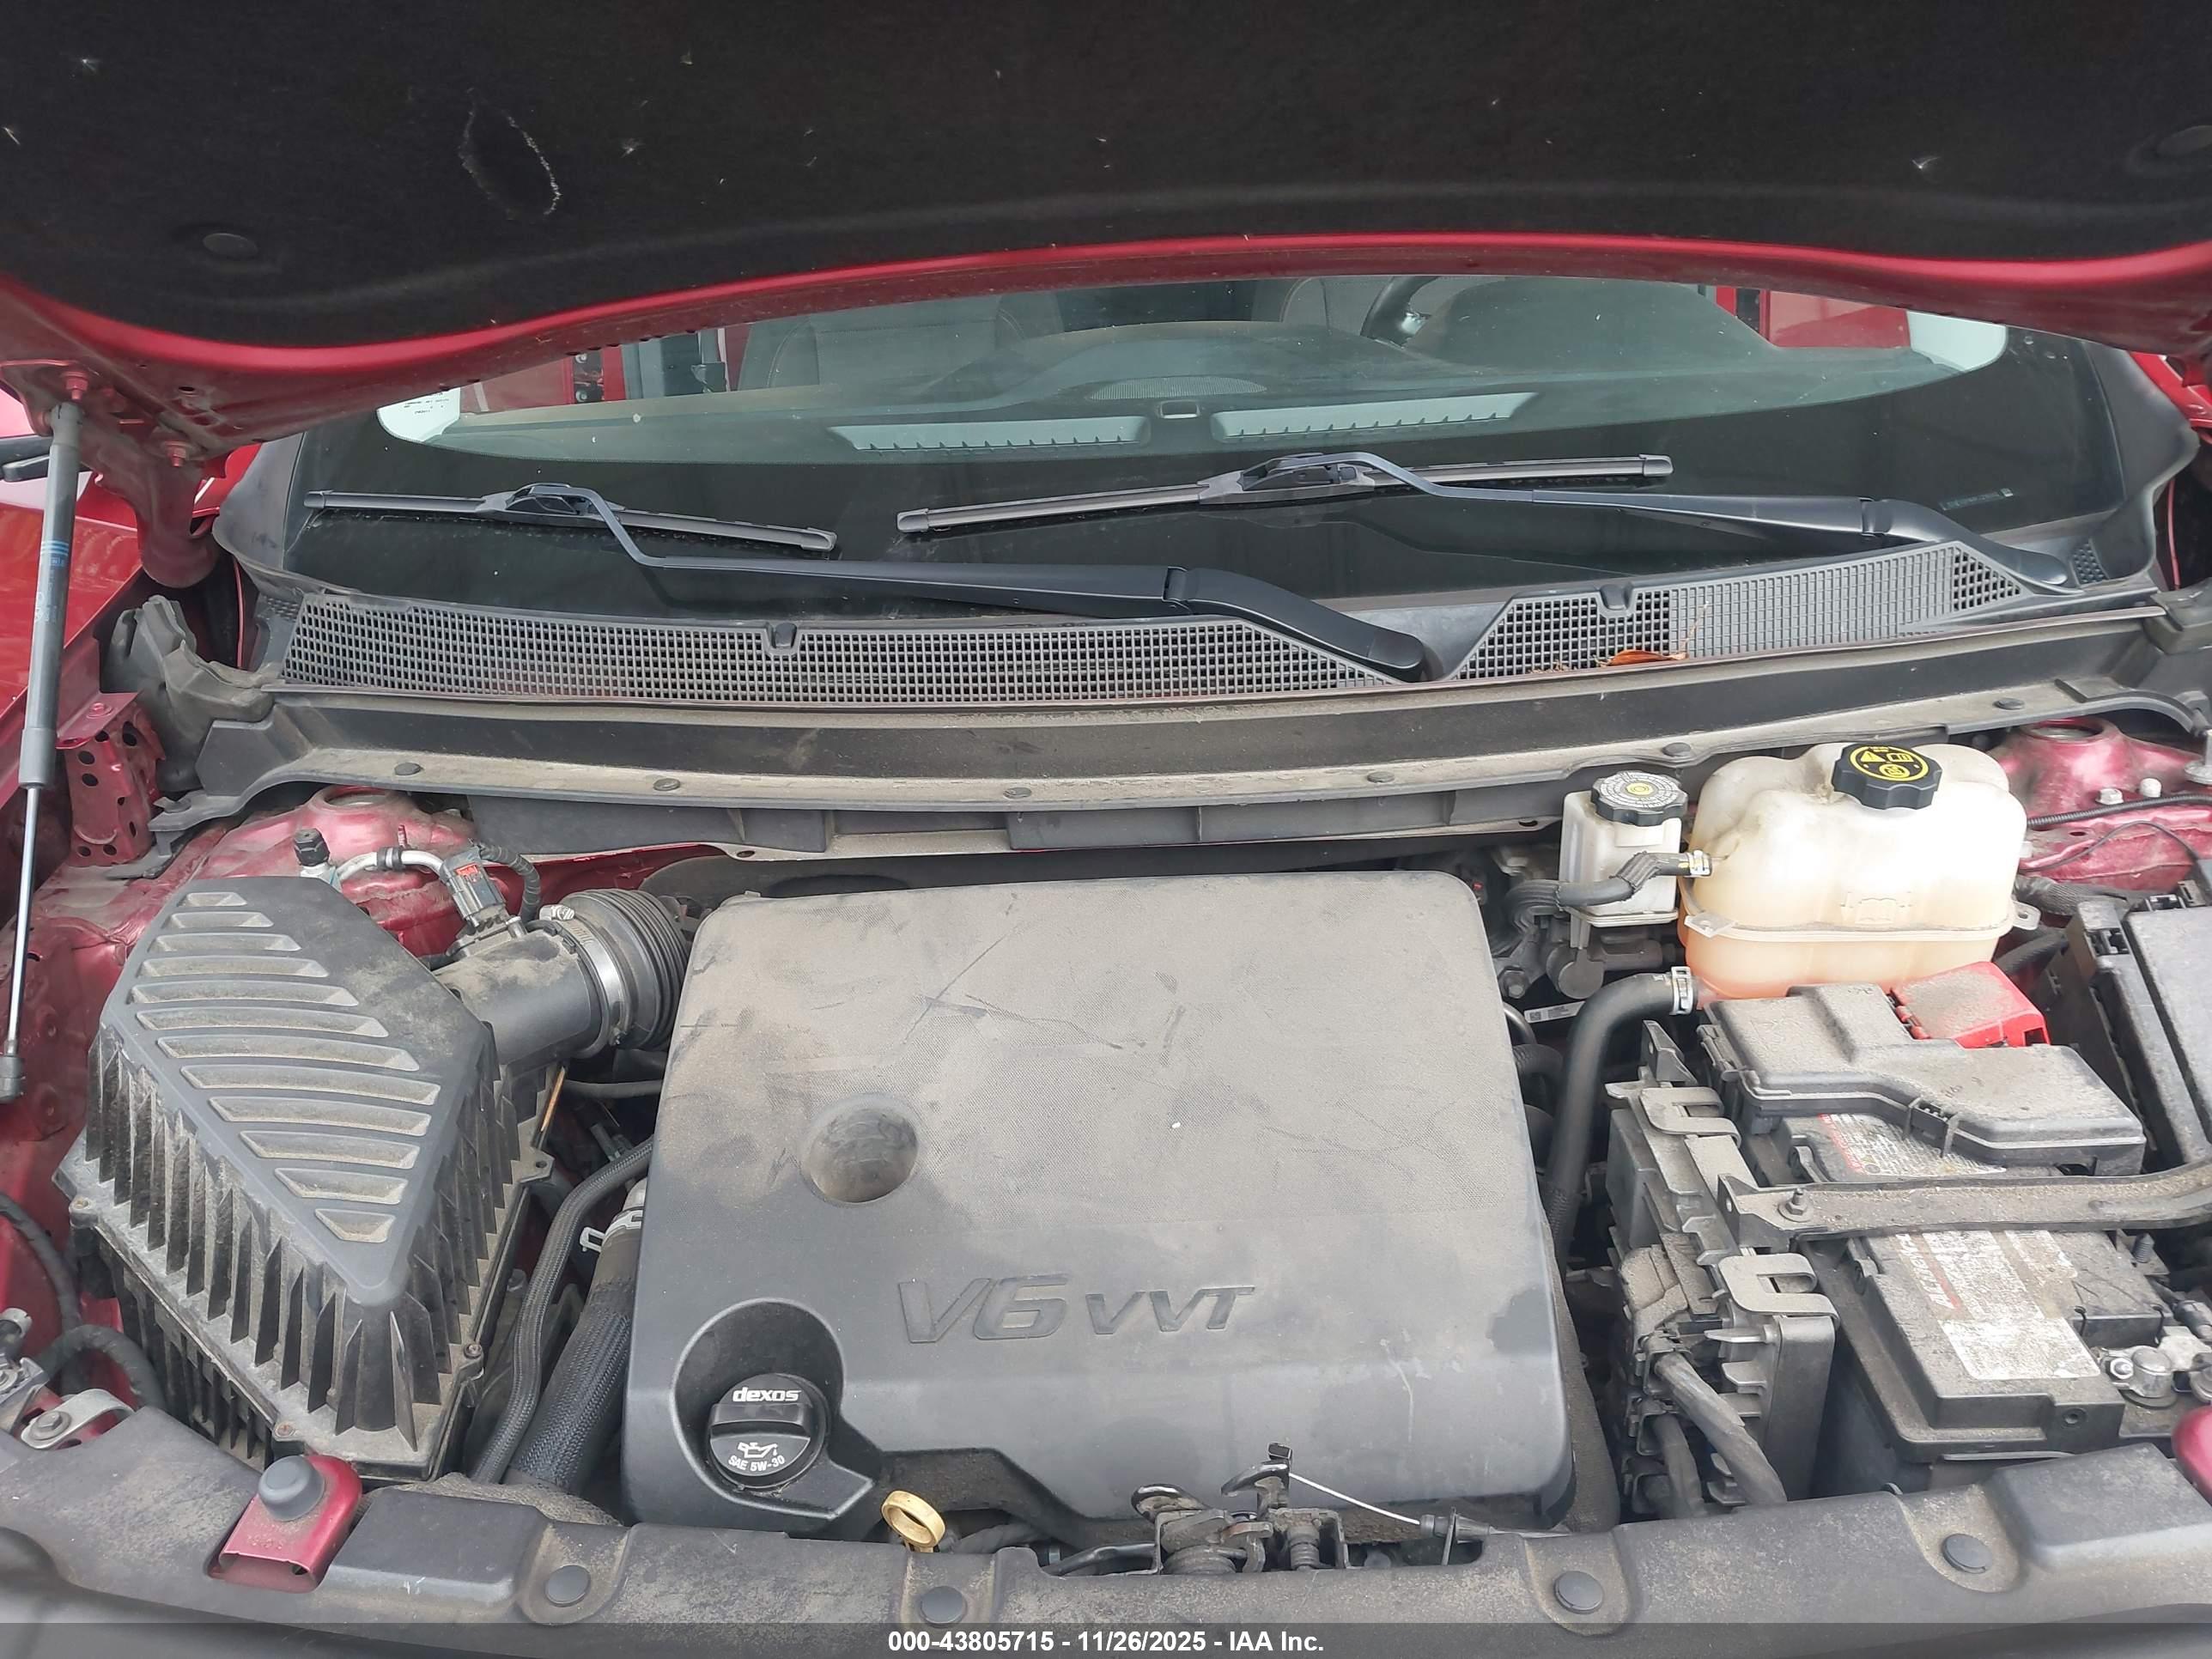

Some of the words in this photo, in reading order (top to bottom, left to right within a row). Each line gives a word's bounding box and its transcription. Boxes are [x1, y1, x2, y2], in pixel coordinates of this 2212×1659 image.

[897, 1273, 1069, 1344] V6
[1085, 1285, 1255, 1336] VVT
[732, 1386, 802, 1402] dexos
[728, 1455, 750, 1471] SAE
[750, 1455, 786, 1472] 5W-30
